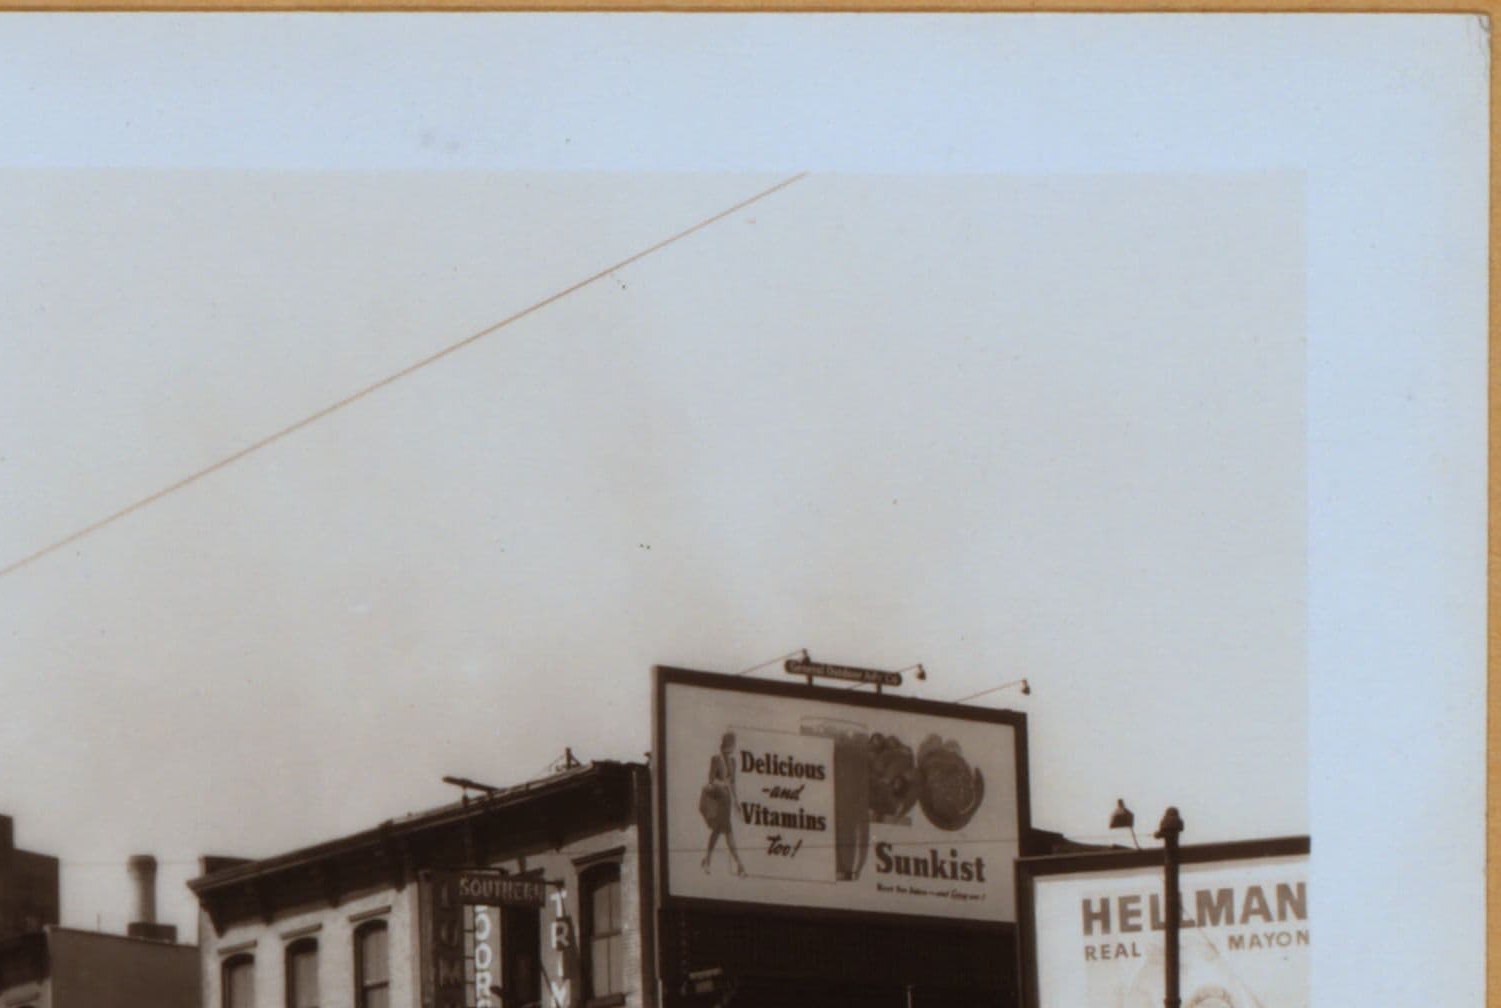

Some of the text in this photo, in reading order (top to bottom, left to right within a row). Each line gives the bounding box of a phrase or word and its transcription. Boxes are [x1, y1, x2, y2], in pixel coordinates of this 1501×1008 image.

[740, 750, 826, 781] Delicious
[741, 801, 827, 832] Vitamins
[875, 841, 986, 883] Sunkist
[1084, 929, 1310, 961] REAL MAYON
